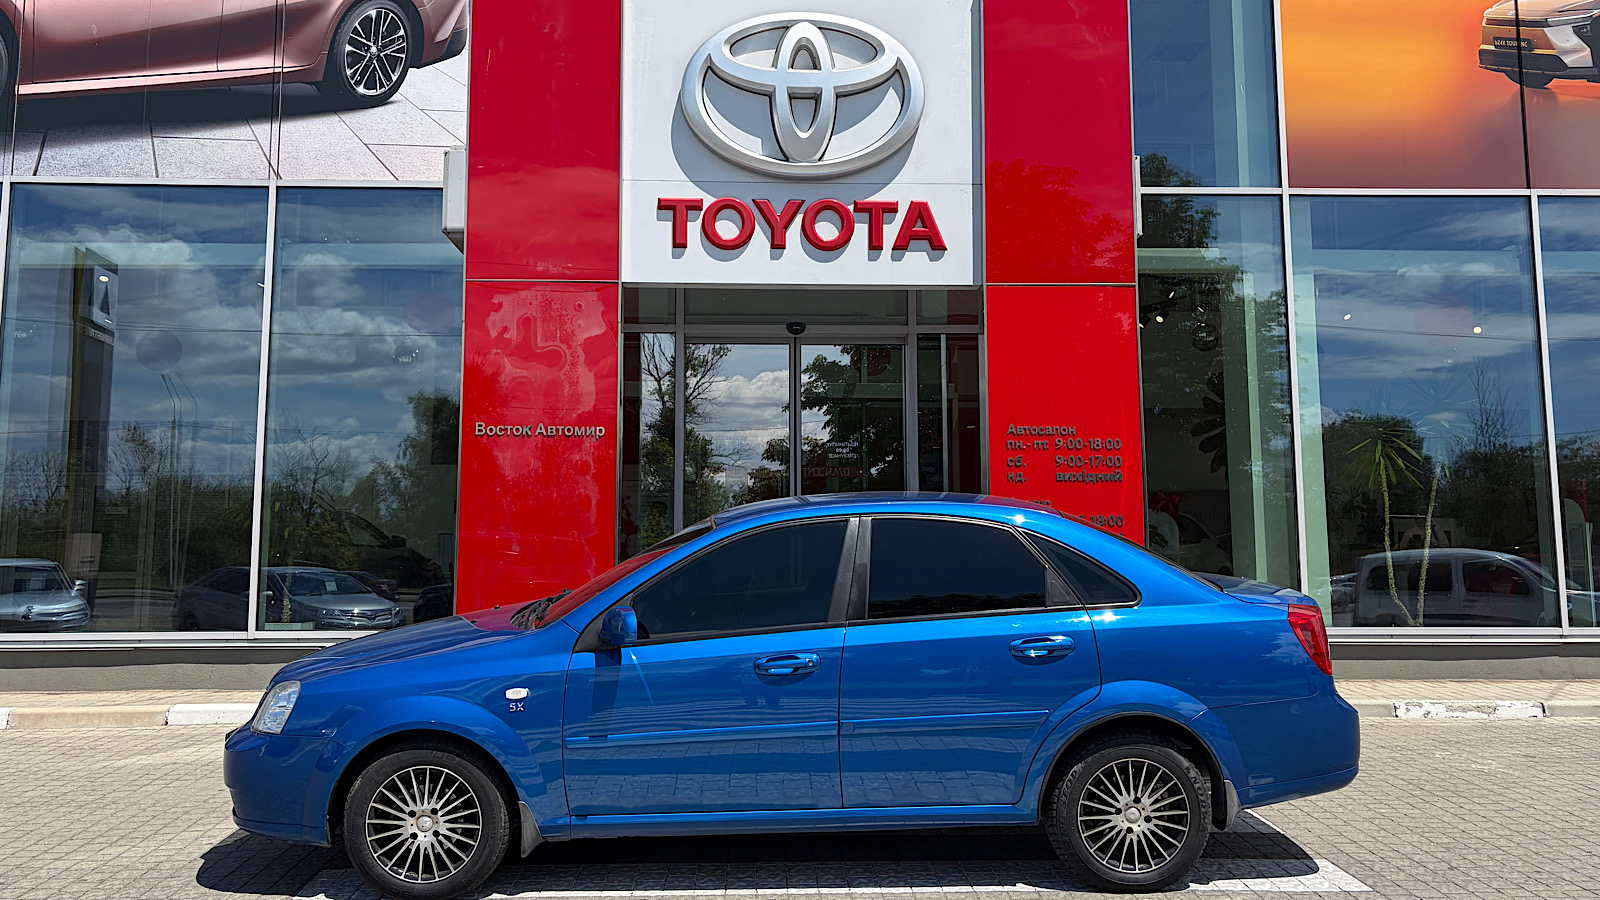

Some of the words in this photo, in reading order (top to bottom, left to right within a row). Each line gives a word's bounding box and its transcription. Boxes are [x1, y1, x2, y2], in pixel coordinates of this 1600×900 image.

[657, 197, 948, 252] TOYOTA
[475, 421, 532, 436] Восток
[535, 423, 605, 440] Автомир
[1006, 424, 1076, 436] Автосалон
[1055, 438, 1122, 451] 9:00-18:00
[1007, 455, 1027, 468] сб.
[1055, 455, 1123, 468] 9:00-17:00
[1007, 472, 1028, 484] нд.
[1056, 470, 1123, 485] вихідний
[509, 702, 524, 712] SX
